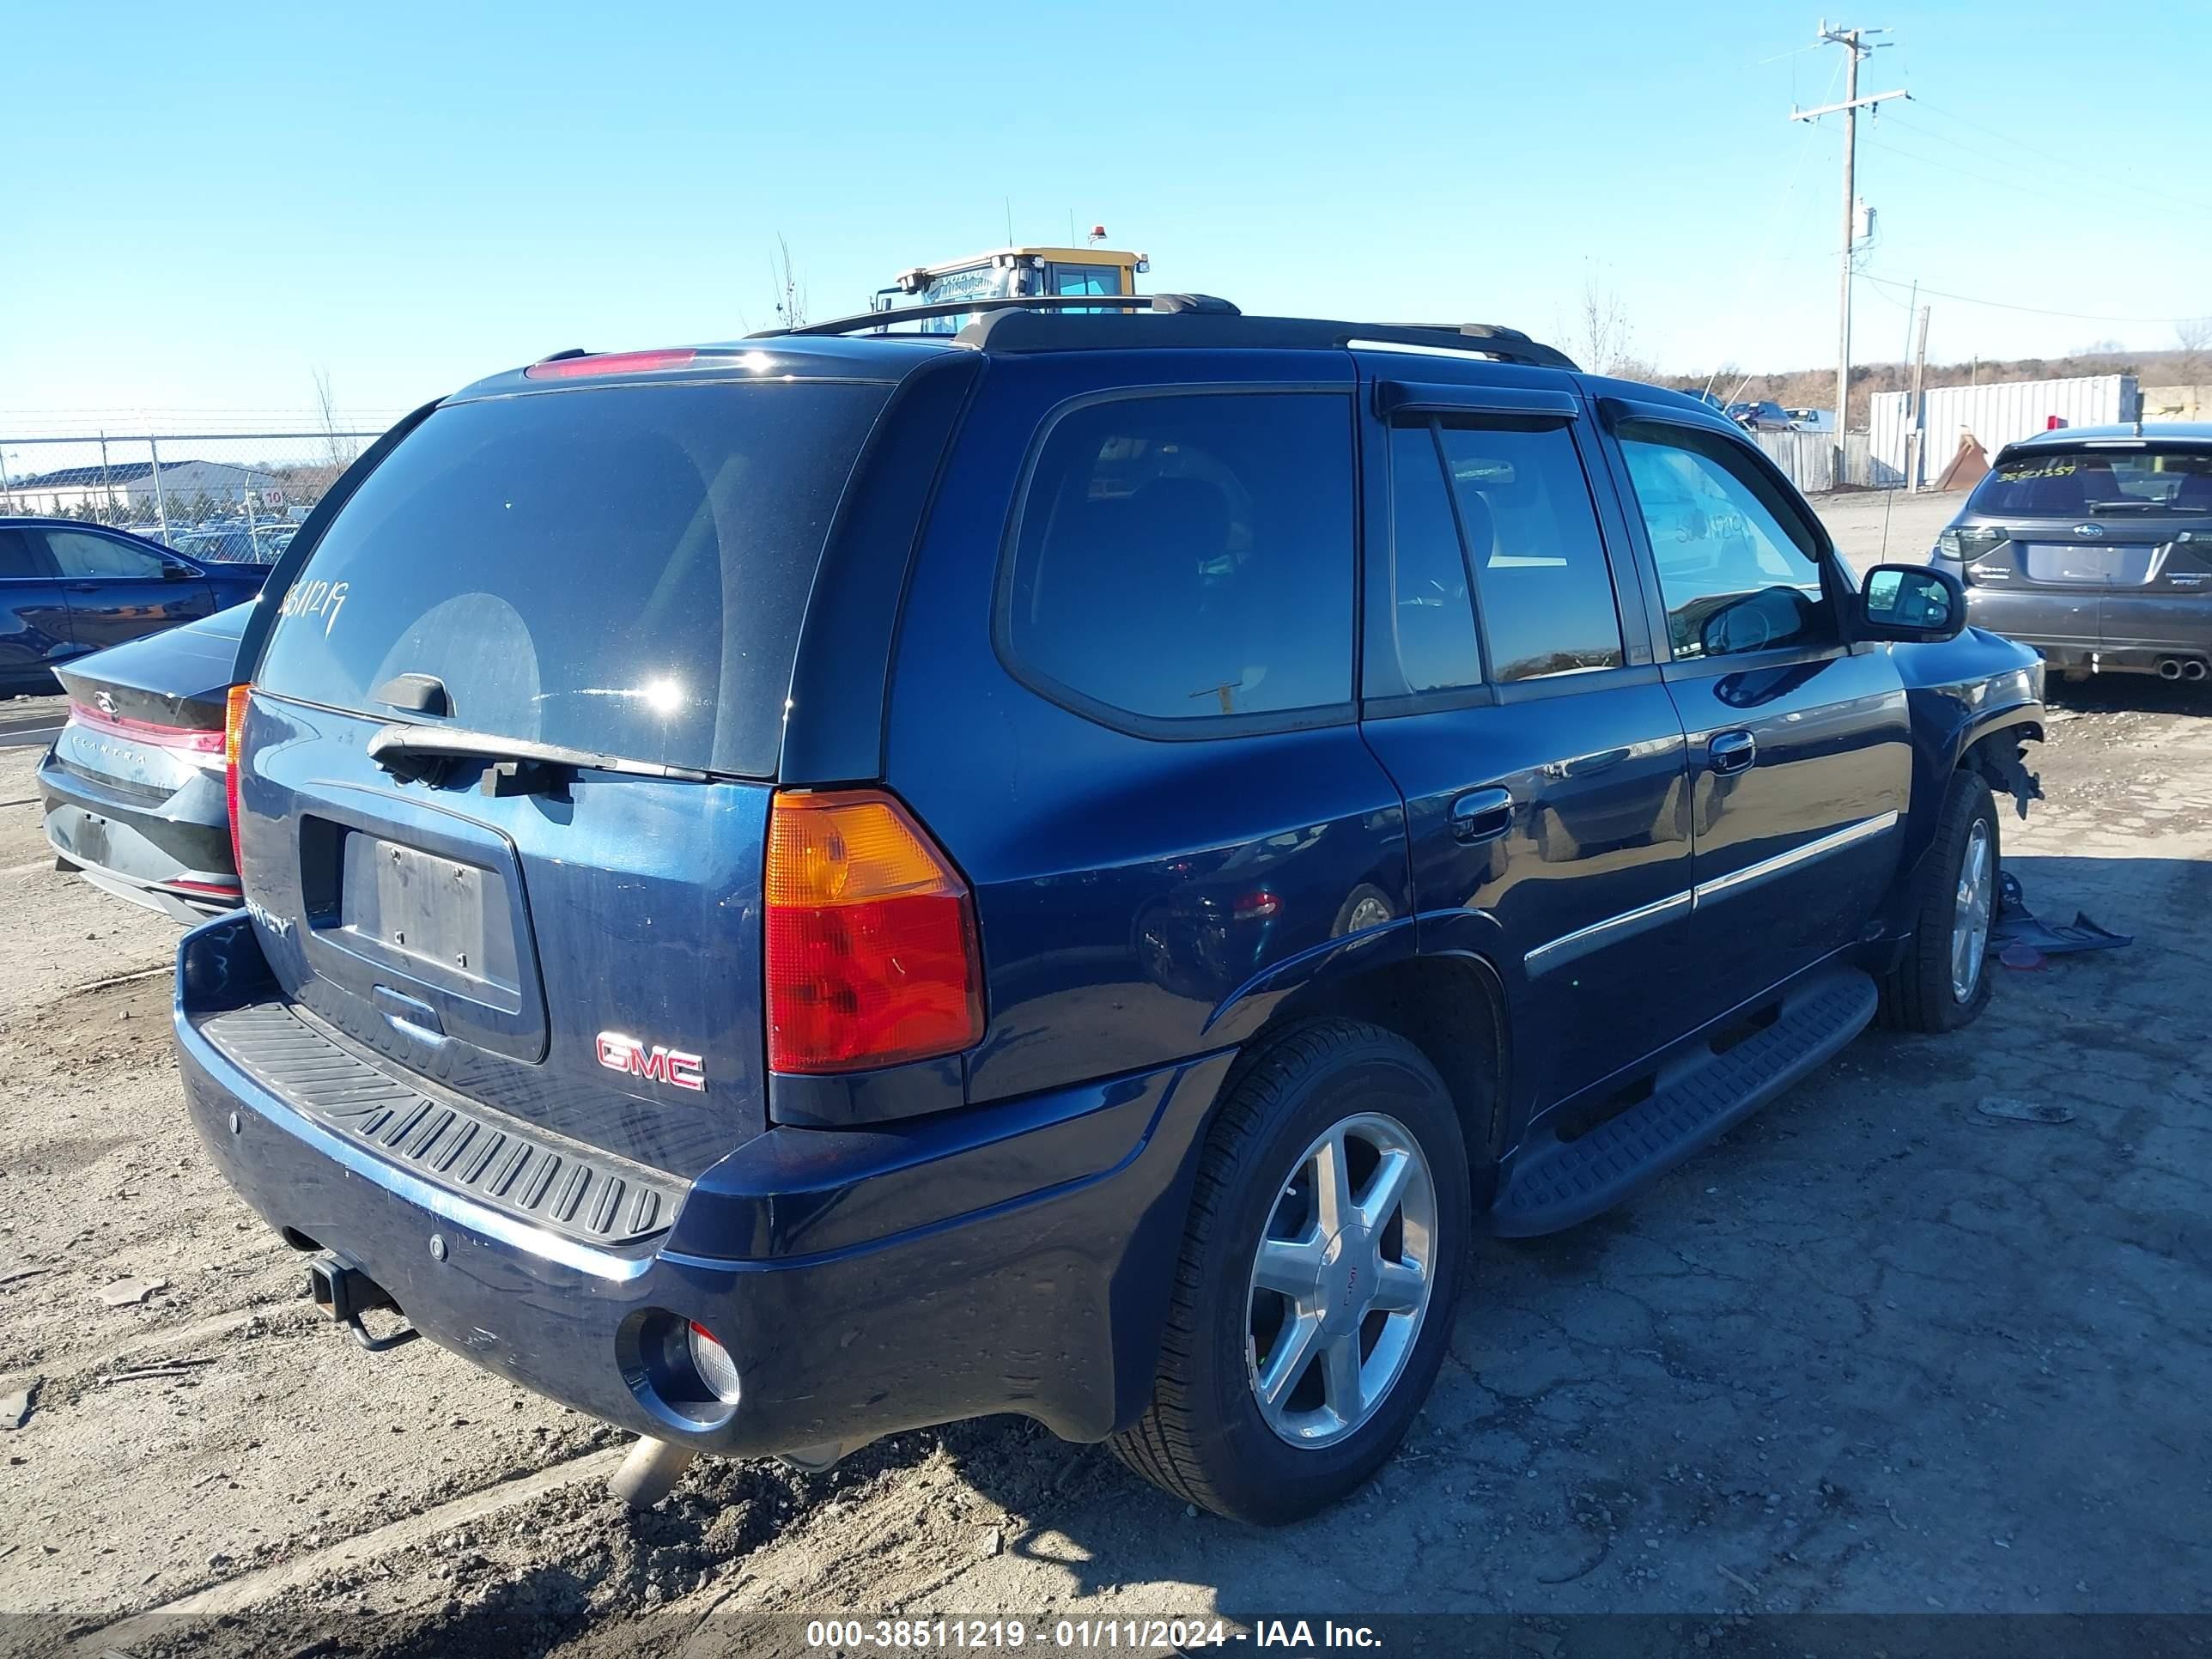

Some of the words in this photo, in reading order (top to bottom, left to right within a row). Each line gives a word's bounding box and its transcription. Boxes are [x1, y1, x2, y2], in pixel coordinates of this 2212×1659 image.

[942, 270, 983, 285] VOLVO
[72, 736, 147, 764] ELANTRA
[596, 1031, 706, 1091] GMC
